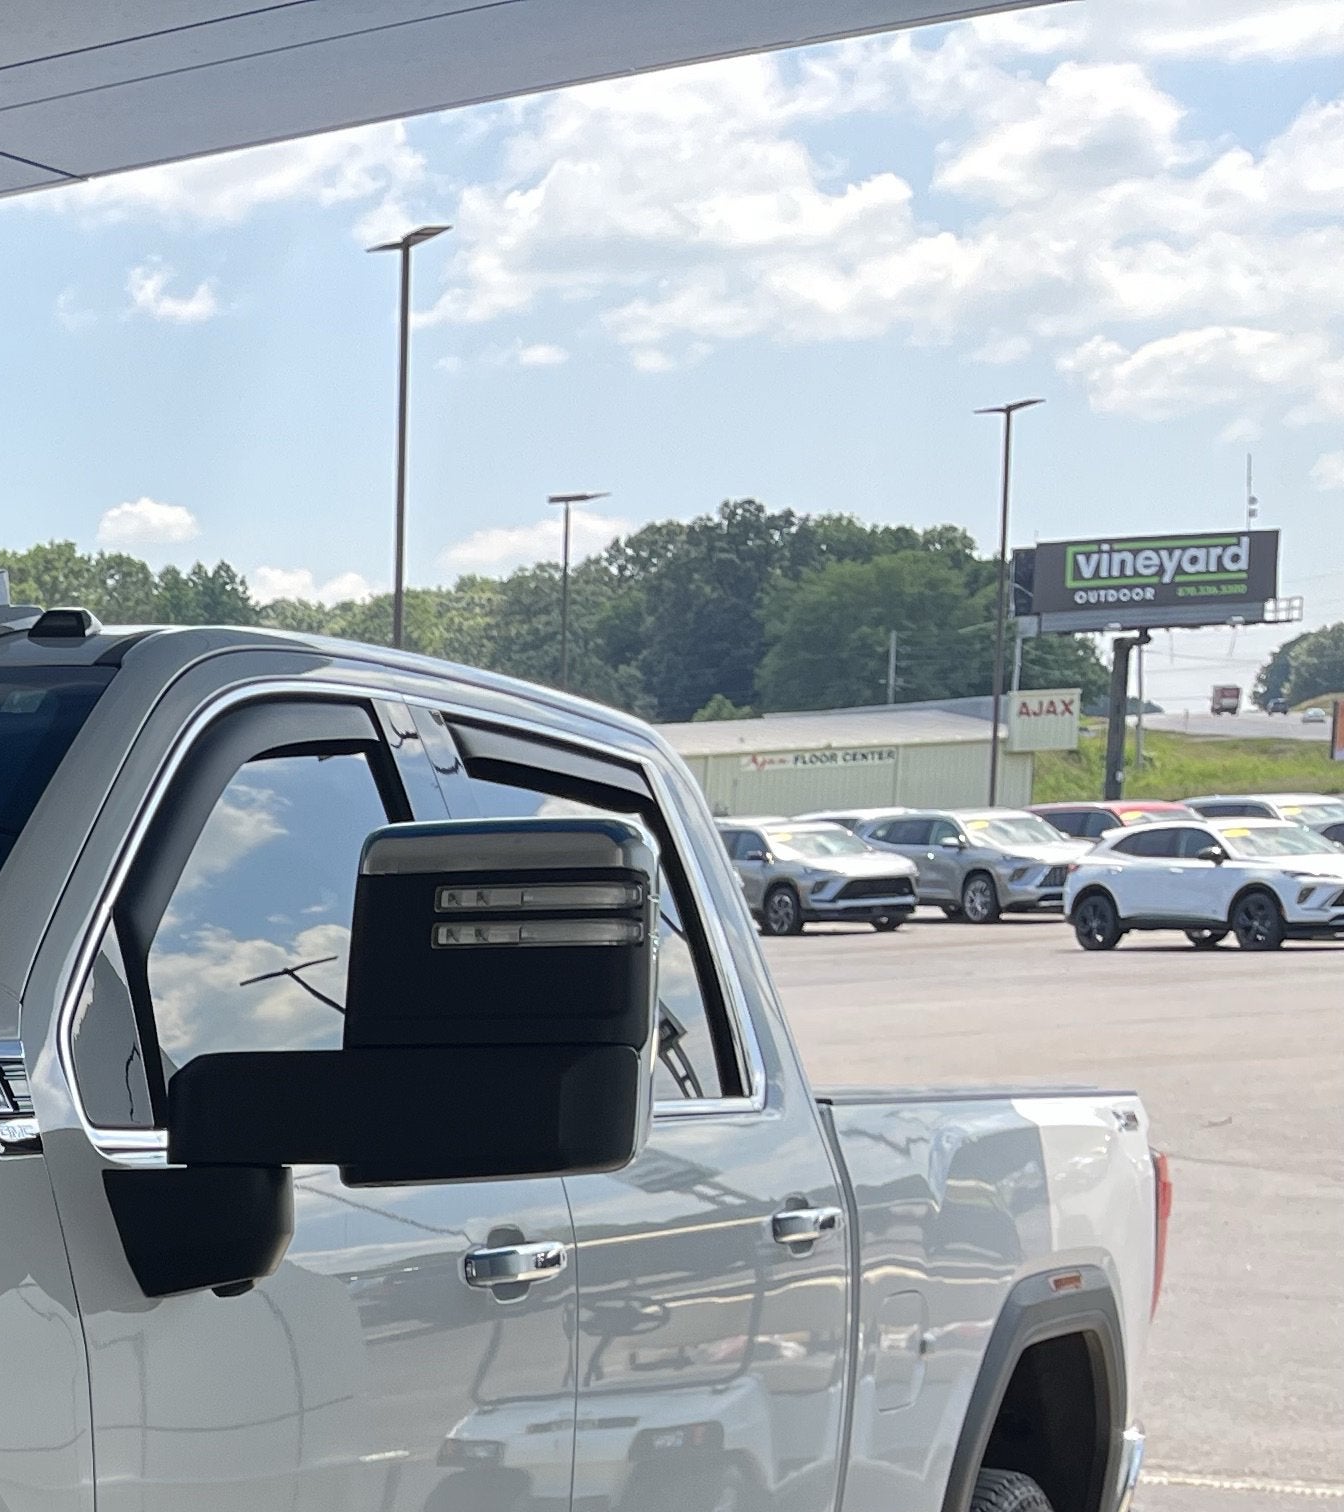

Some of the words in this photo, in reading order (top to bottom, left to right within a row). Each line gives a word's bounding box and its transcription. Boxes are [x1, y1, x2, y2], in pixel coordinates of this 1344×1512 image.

[1076, 536, 1250, 584] vineyard
[1074, 587, 1156, 604] OUTDOOR
[1018, 700, 1075, 718] AJAX
[794, 752, 838, 765] FLOOR
[842, 750, 896, 762] CENTER
